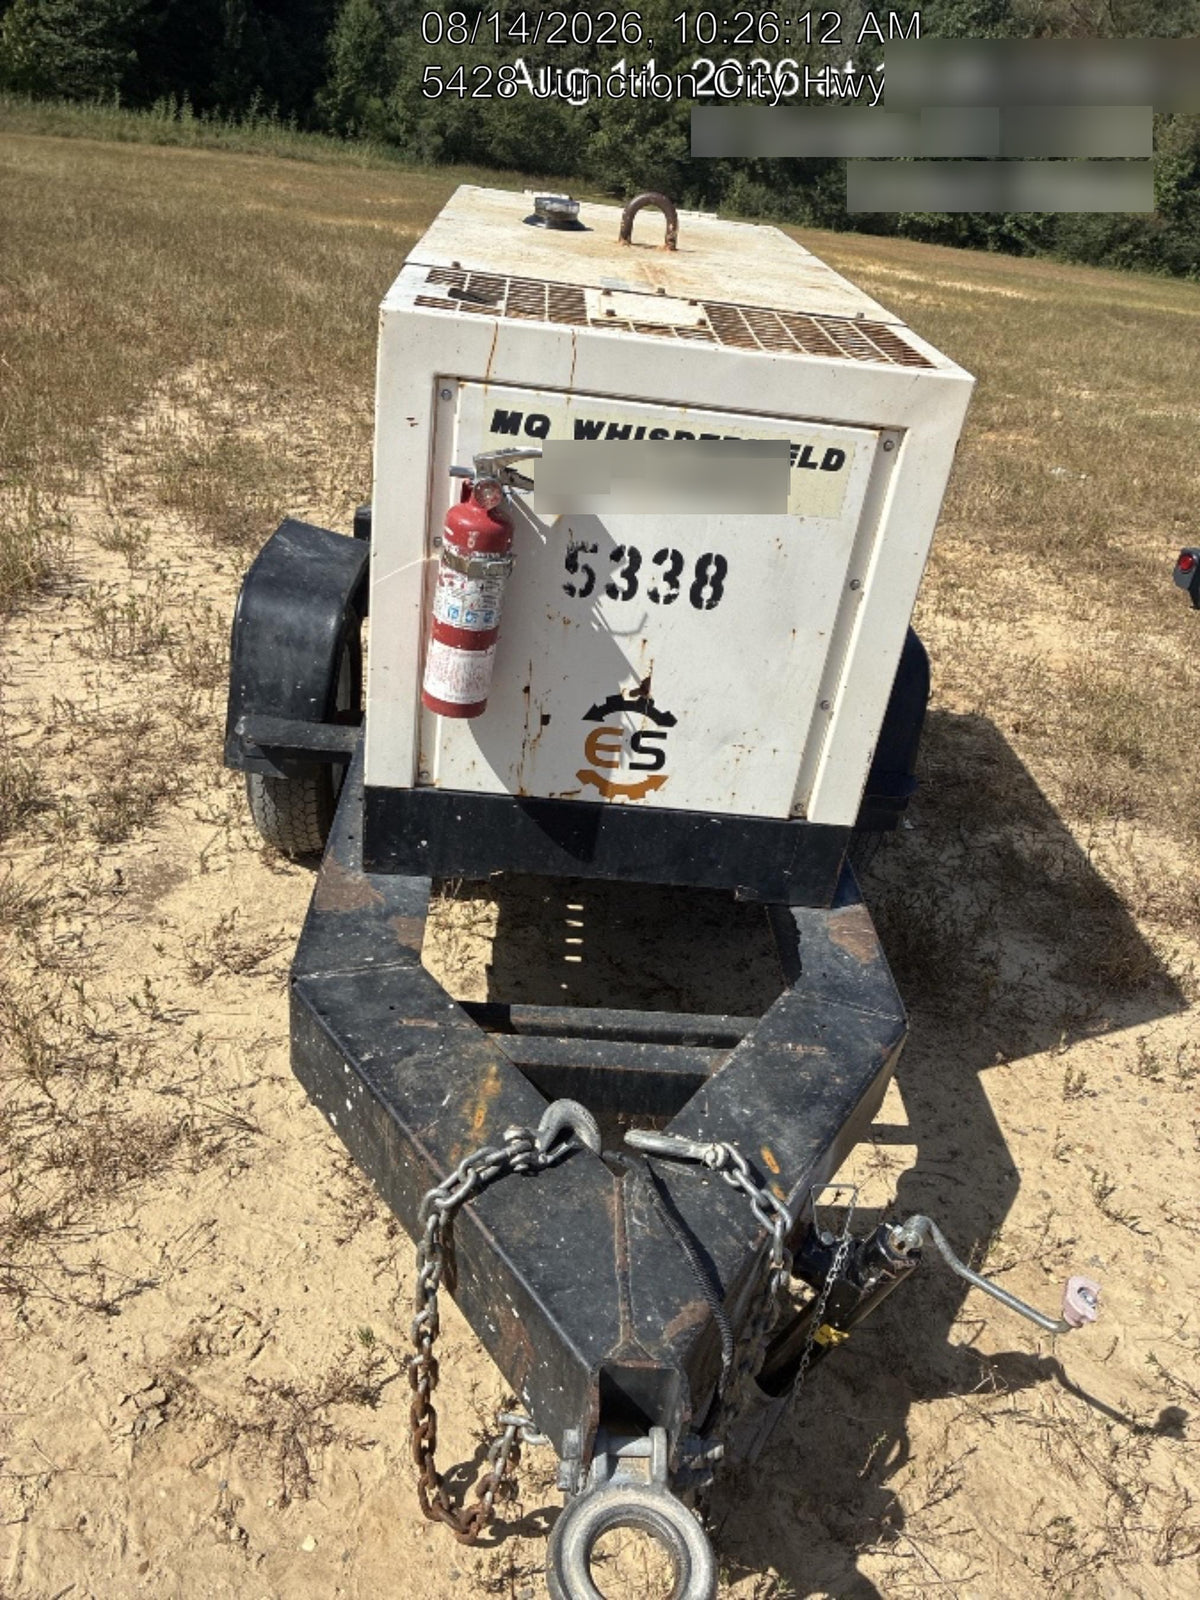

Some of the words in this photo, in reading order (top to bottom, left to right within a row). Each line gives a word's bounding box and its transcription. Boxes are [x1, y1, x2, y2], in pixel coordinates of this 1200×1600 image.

[490, 408, 552, 439] MQ
[562, 541, 729, 611] 5338
[584, 726, 668, 772] ES
